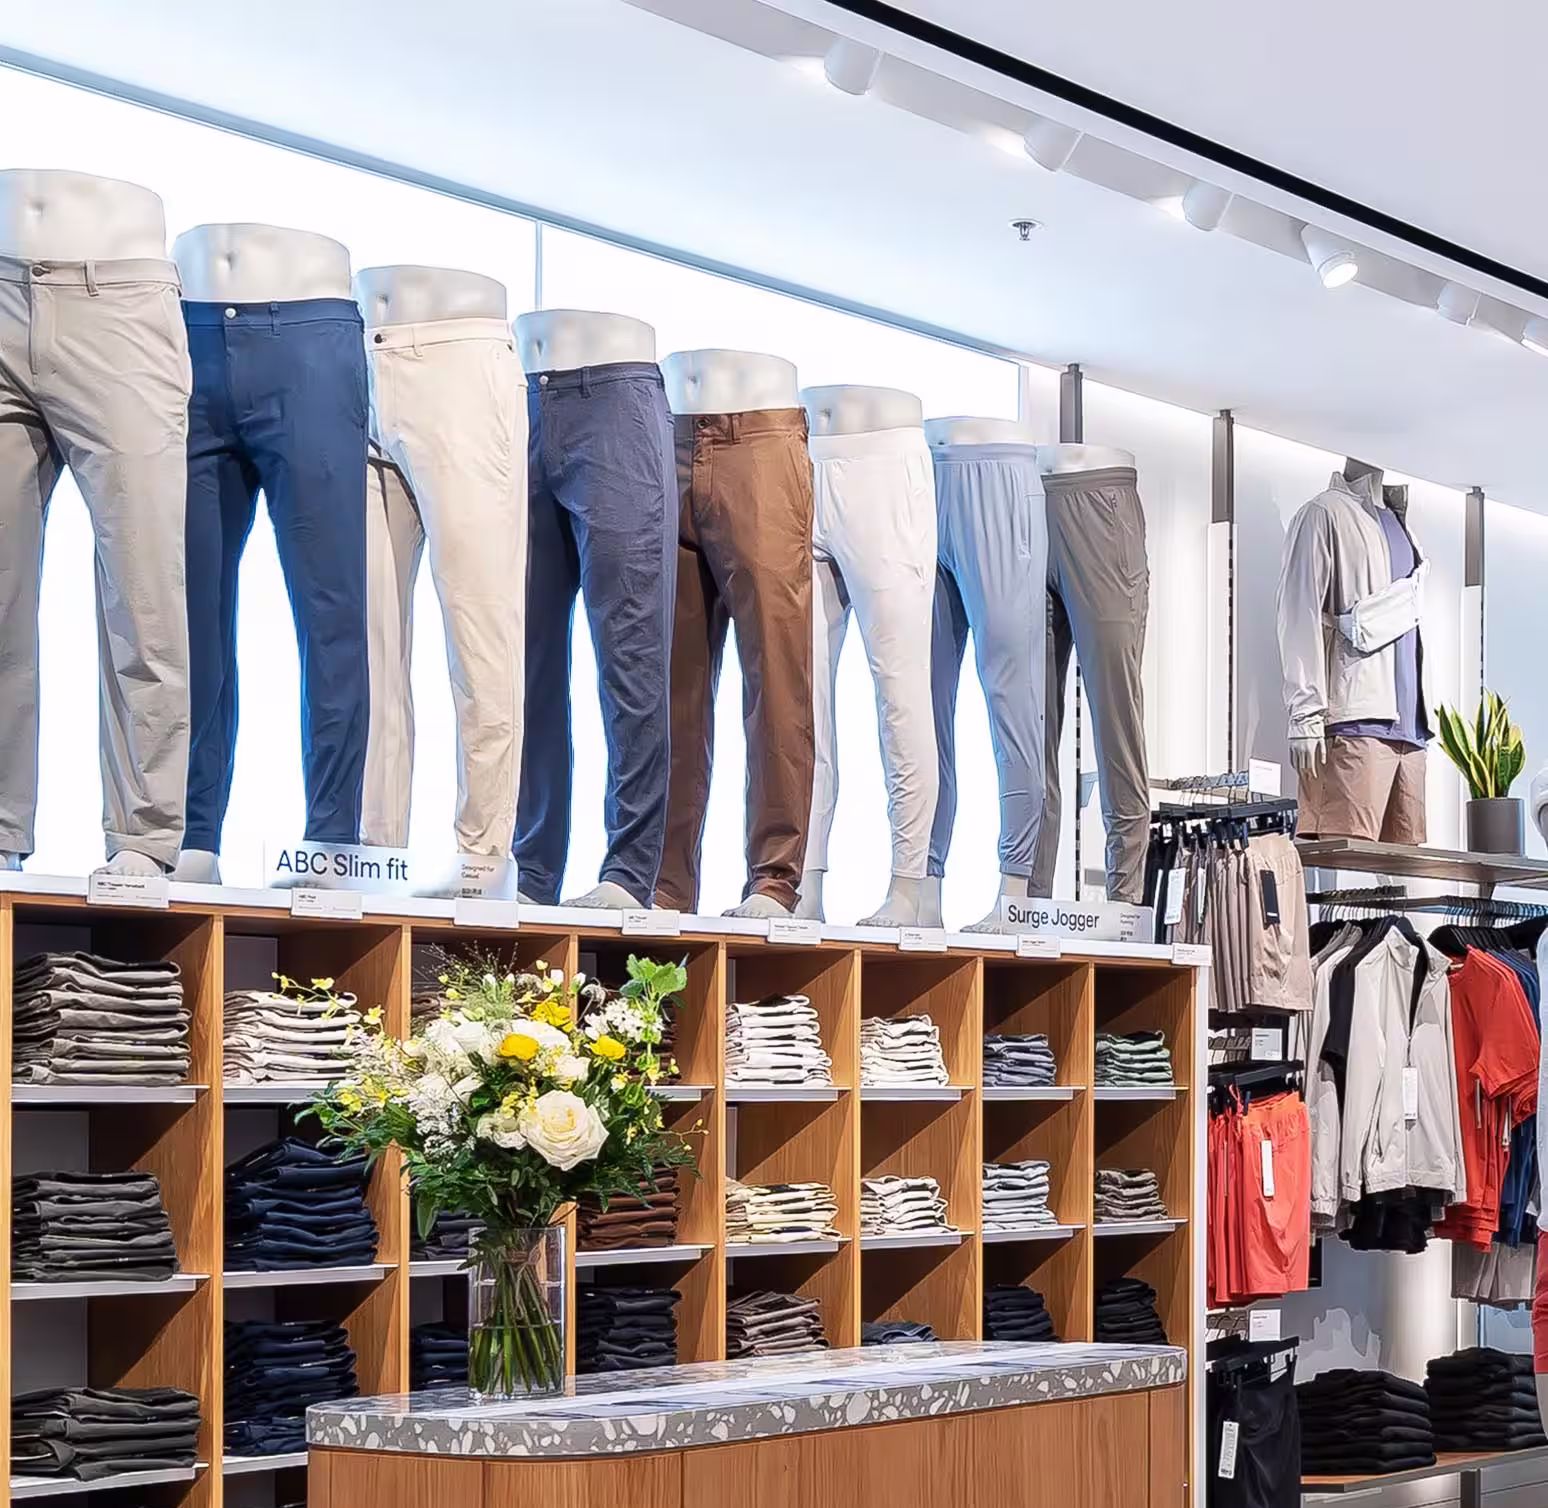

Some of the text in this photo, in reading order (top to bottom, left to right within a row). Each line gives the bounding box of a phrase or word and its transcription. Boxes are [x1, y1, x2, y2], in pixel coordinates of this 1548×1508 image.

[276, 849, 409, 881] ABC Slim fit
[1008, 904, 1100, 932] Surge Jogger
